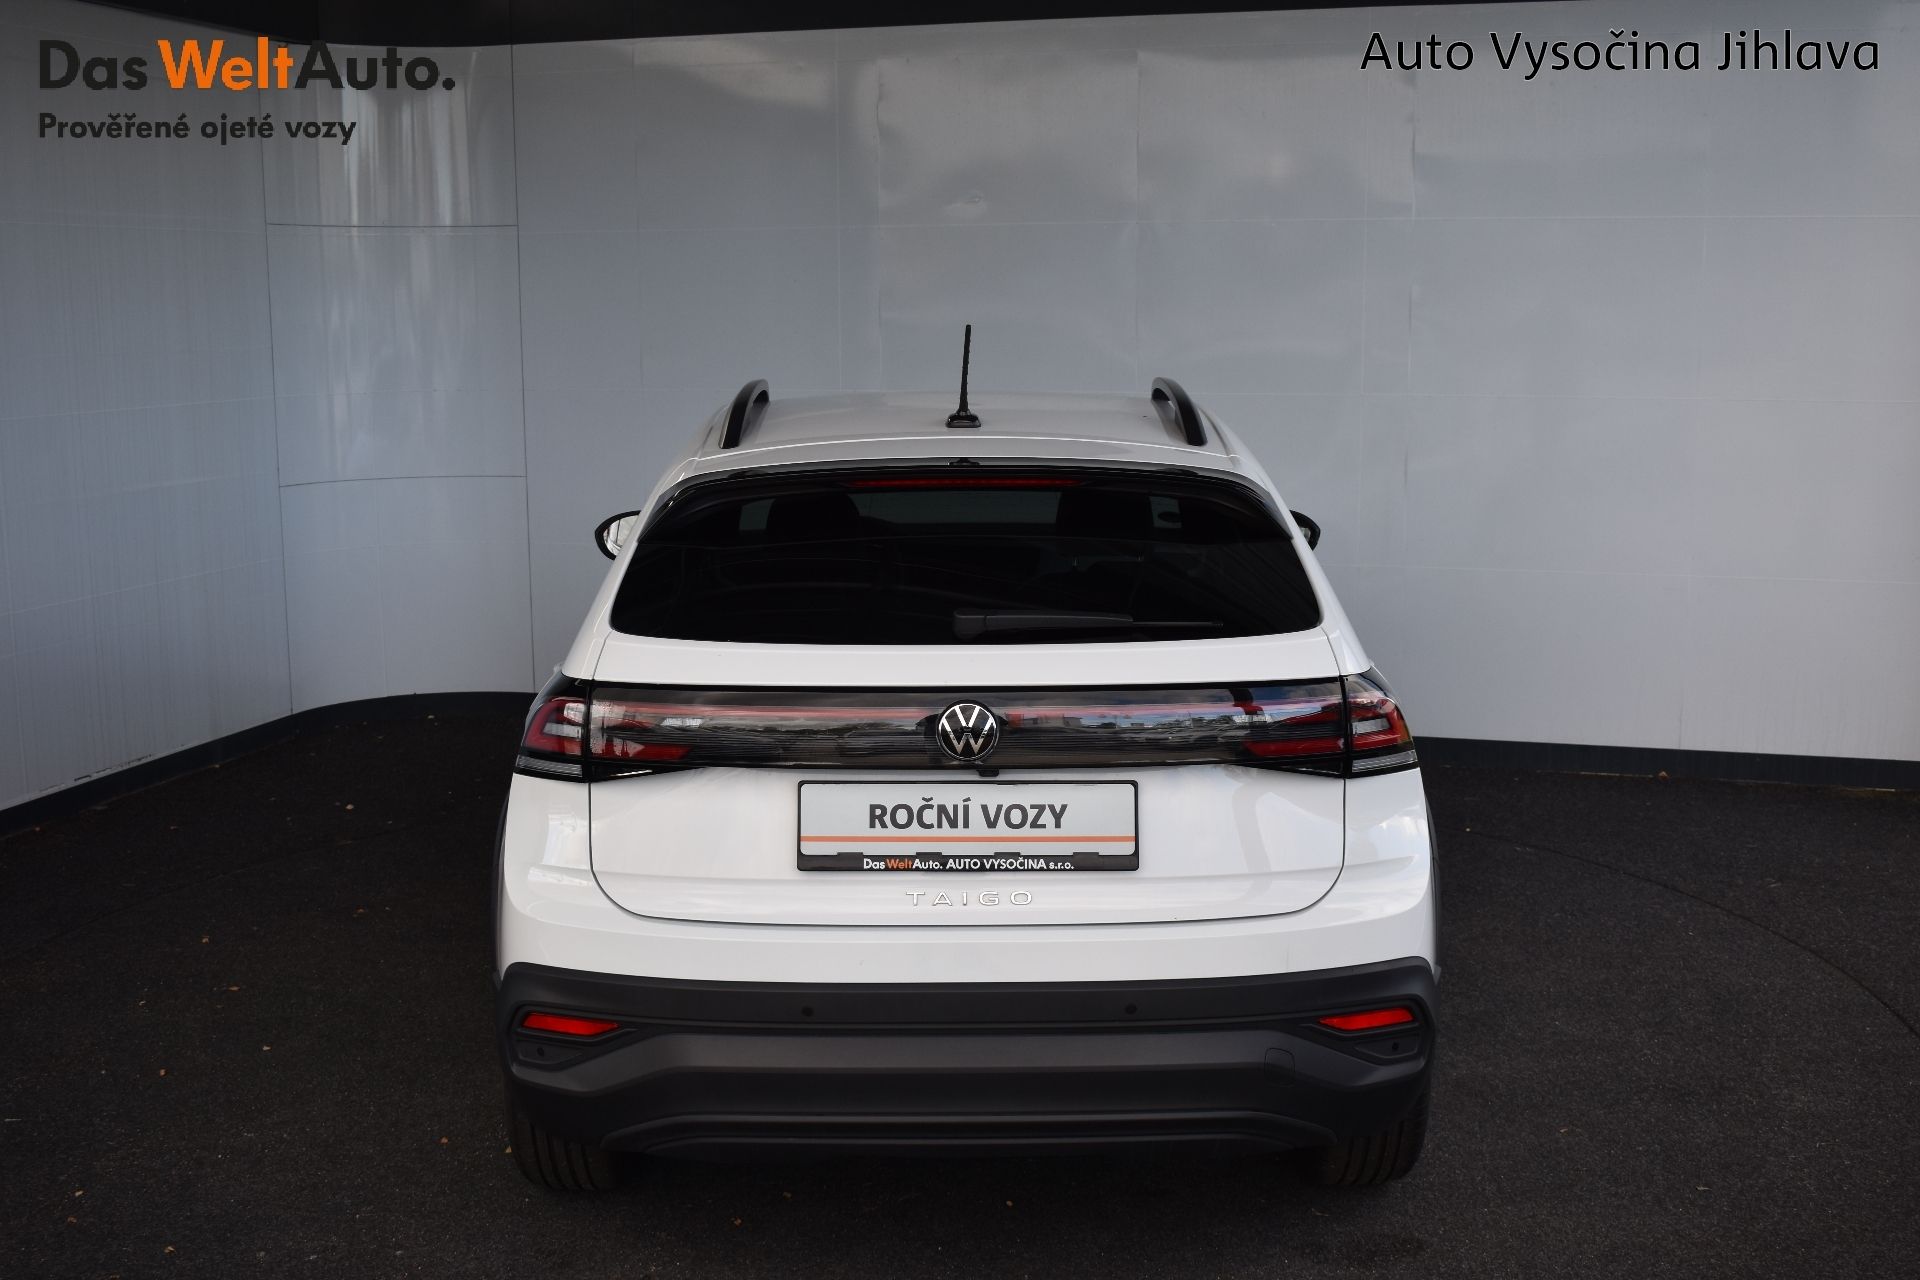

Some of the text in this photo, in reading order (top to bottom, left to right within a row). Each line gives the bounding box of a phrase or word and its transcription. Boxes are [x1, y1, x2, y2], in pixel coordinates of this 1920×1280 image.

[868, 796, 1068, 830] ROČNÍ VOZY
[946, 858, 981, 871] AUTO
[984, 856, 1047, 870] VYSOČINA
[1049, 861, 1075, 870] s.r.o.
[906, 890, 1034, 907] TAIGO
